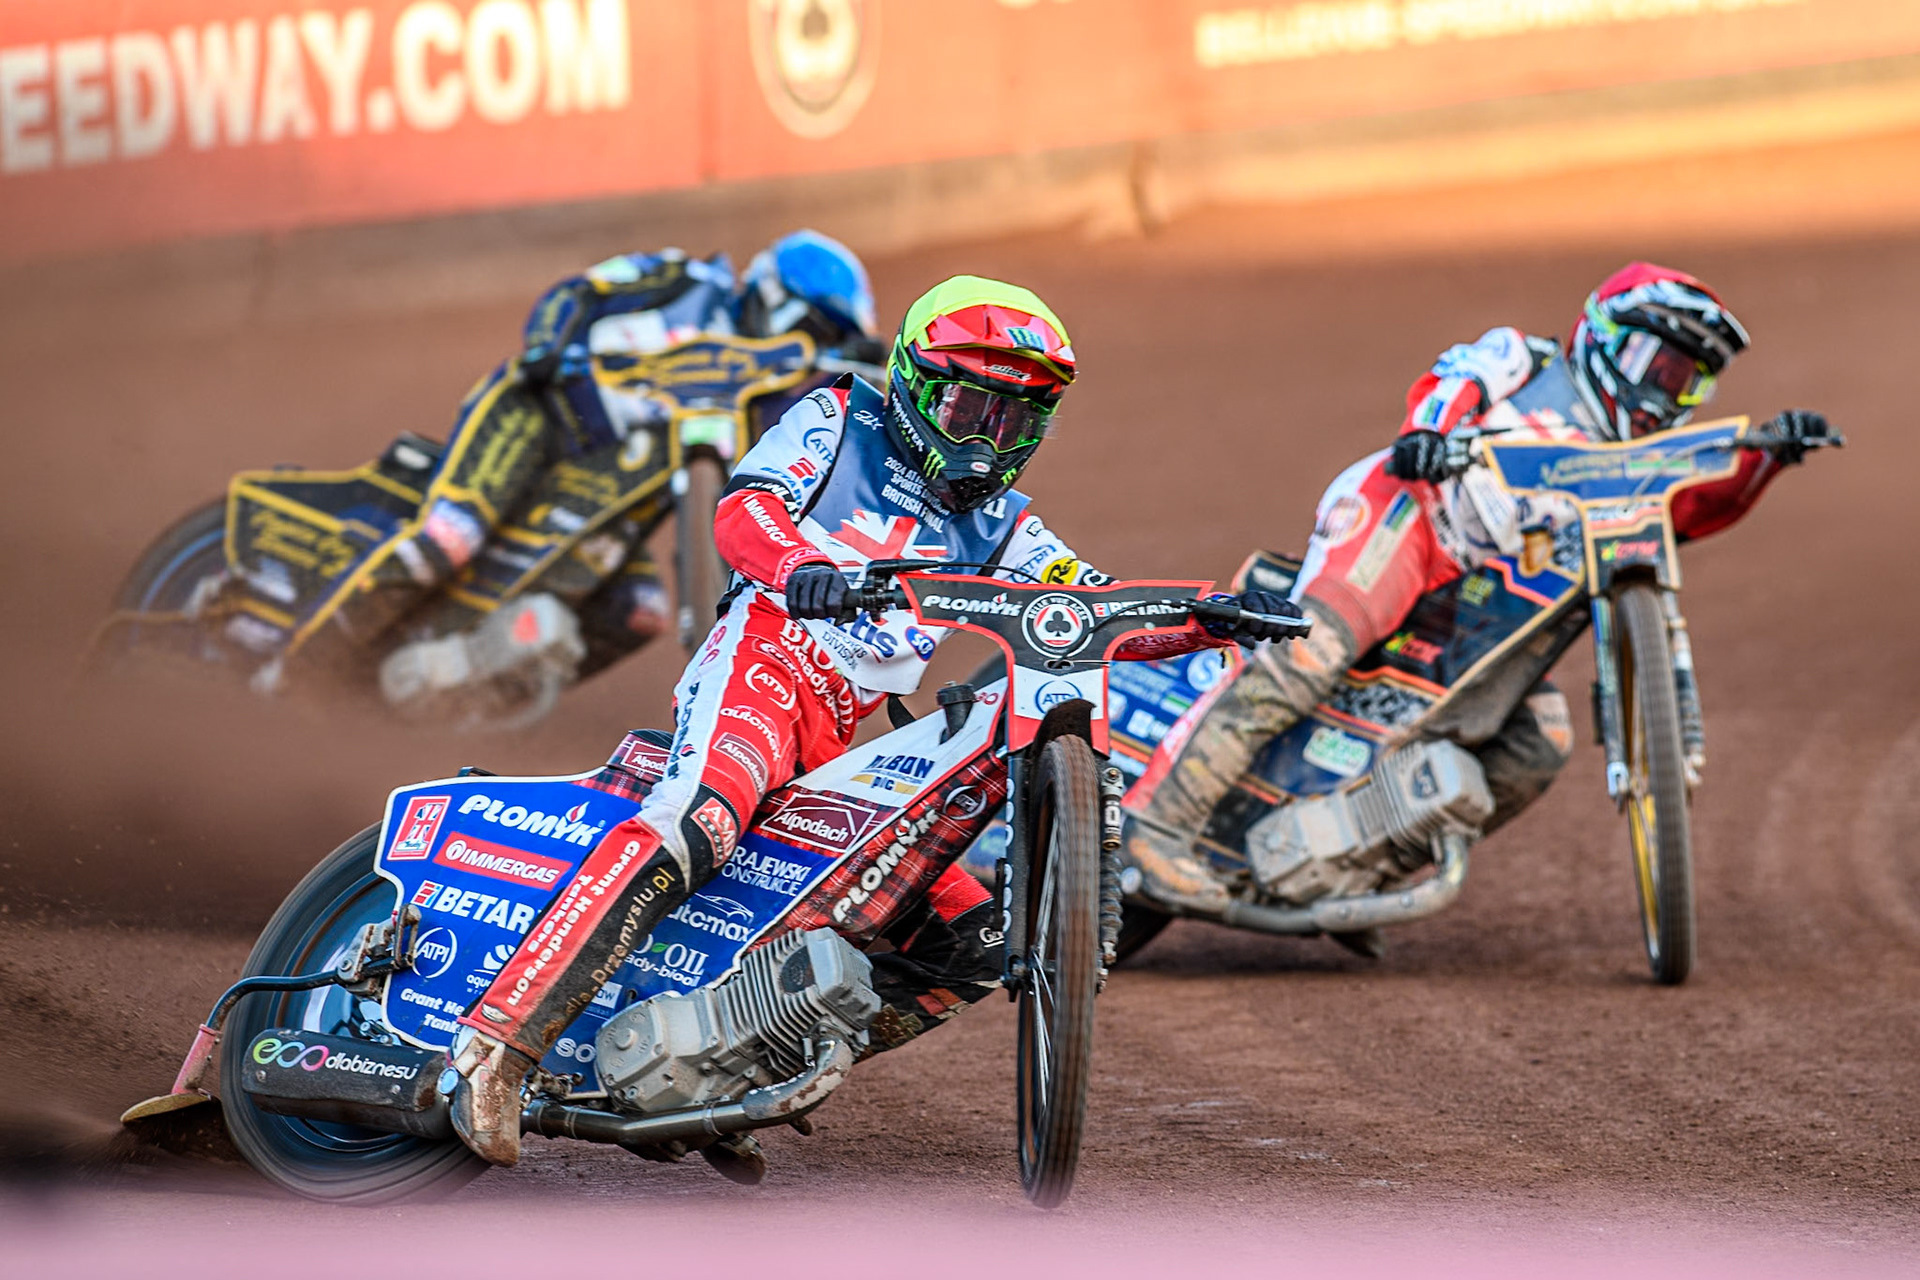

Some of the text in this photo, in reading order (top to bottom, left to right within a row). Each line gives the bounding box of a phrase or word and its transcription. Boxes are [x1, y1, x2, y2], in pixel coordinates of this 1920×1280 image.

[884, 456, 907, 475] 2024
[890, 472, 923, 495] SPORTS
[881, 483, 945, 534] BRITISH FINAL
[753, 672, 789, 701] ATPI
[774, 809, 848, 843] Alpodach
[458, 847, 560, 884] IMMERGAS
[728, 845, 813, 882] RAJEWSKI
[433, 886, 541, 936] BETAR
[506, 841, 641, 1006] Grant Henderson
[416, 940, 450, 964] ATPI
[624, 953, 702, 988] ady-biool
[400, 987, 444, 1011] Grant
[442, 1000, 466, 1017] He
[555, 1036, 597, 1064] SO
